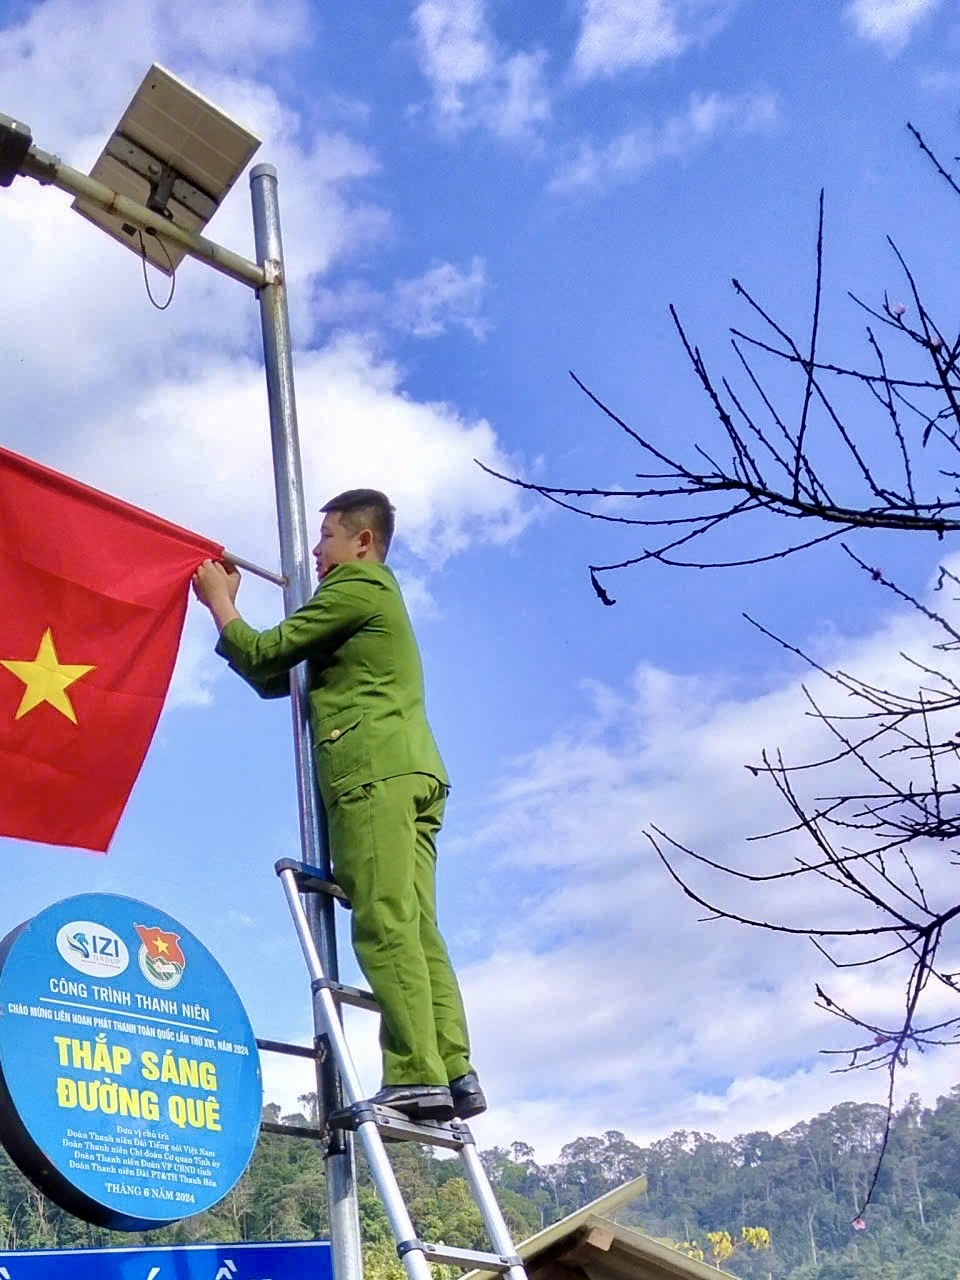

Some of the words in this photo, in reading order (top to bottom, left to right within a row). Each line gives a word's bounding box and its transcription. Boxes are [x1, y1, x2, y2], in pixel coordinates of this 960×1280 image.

[92, 935, 119, 957] IZI
[93, 954, 121, 965] GROUP
[49, 978, 88, 998] CÔNG
[92, 985, 131, 1006] TRÌNH
[135, 994, 178, 1015] THANH
[182, 1003, 210, 1022] NIÊN
[8, 1003, 28, 1016] CHÀO
[54, 1010, 71, 1022] LIÊN
[72, 1014, 93, 1026] HOAN
[94, 1017, 112, 1029] PHÁT
[113, 1021, 136, 1034] THANH
[137, 1025, 156, 1037] TOÀN
[157, 1028, 175, 1041] QUỐC
[233, 1045, 249, 1056] 2024
[54, 1033, 132, 1075] THẮP
[140, 1050, 218, 1091] SÁNG
[56, 1077, 160, 1121] ĐƯỜNG
[168, 1096, 222, 1131] QUÊ
[67, 1128, 88, 1139] Đoàn
[89, 1131, 114, 1143] Thanh
[116, 1136, 133, 1145] niên
[149, 1140, 169, 1151] Tiếng
[184, 1145, 198, 1155] Việt
[199, 1148, 215, 1157] Nam
[116, 1125, 132, 1135] Đơn
[134, 1128, 142, 1138] vị
[62, 1138, 83, 1149] Đoàn
[84, 1141, 110, 1152] Thanh
[111, 1146, 128, 1155] niên
[144, 1149, 162, 1159] đoàn
[175, 1156, 193, 1164] quan
[74, 1150, 95, 1161] Đoàn
[95, 1153, 121, 1164] Thanh
[122, 1158, 140, 1166] niên
[161, 1161, 172, 1170] VP
[173, 1163, 196, 1174] UBND
[69, 1160, 90, 1170] Đoàn
[91, 1163, 116, 1174] Thanh
[118, 1167, 135, 1176] niên
[179, 1174, 202, 1185] Thanh
[105, 1182, 142, 1196] THÁNG
[143, 1188, 150, 1197] 6
[151, 1187, 174, 1200] NĂM
[175, 1191, 195, 1203] 2024
